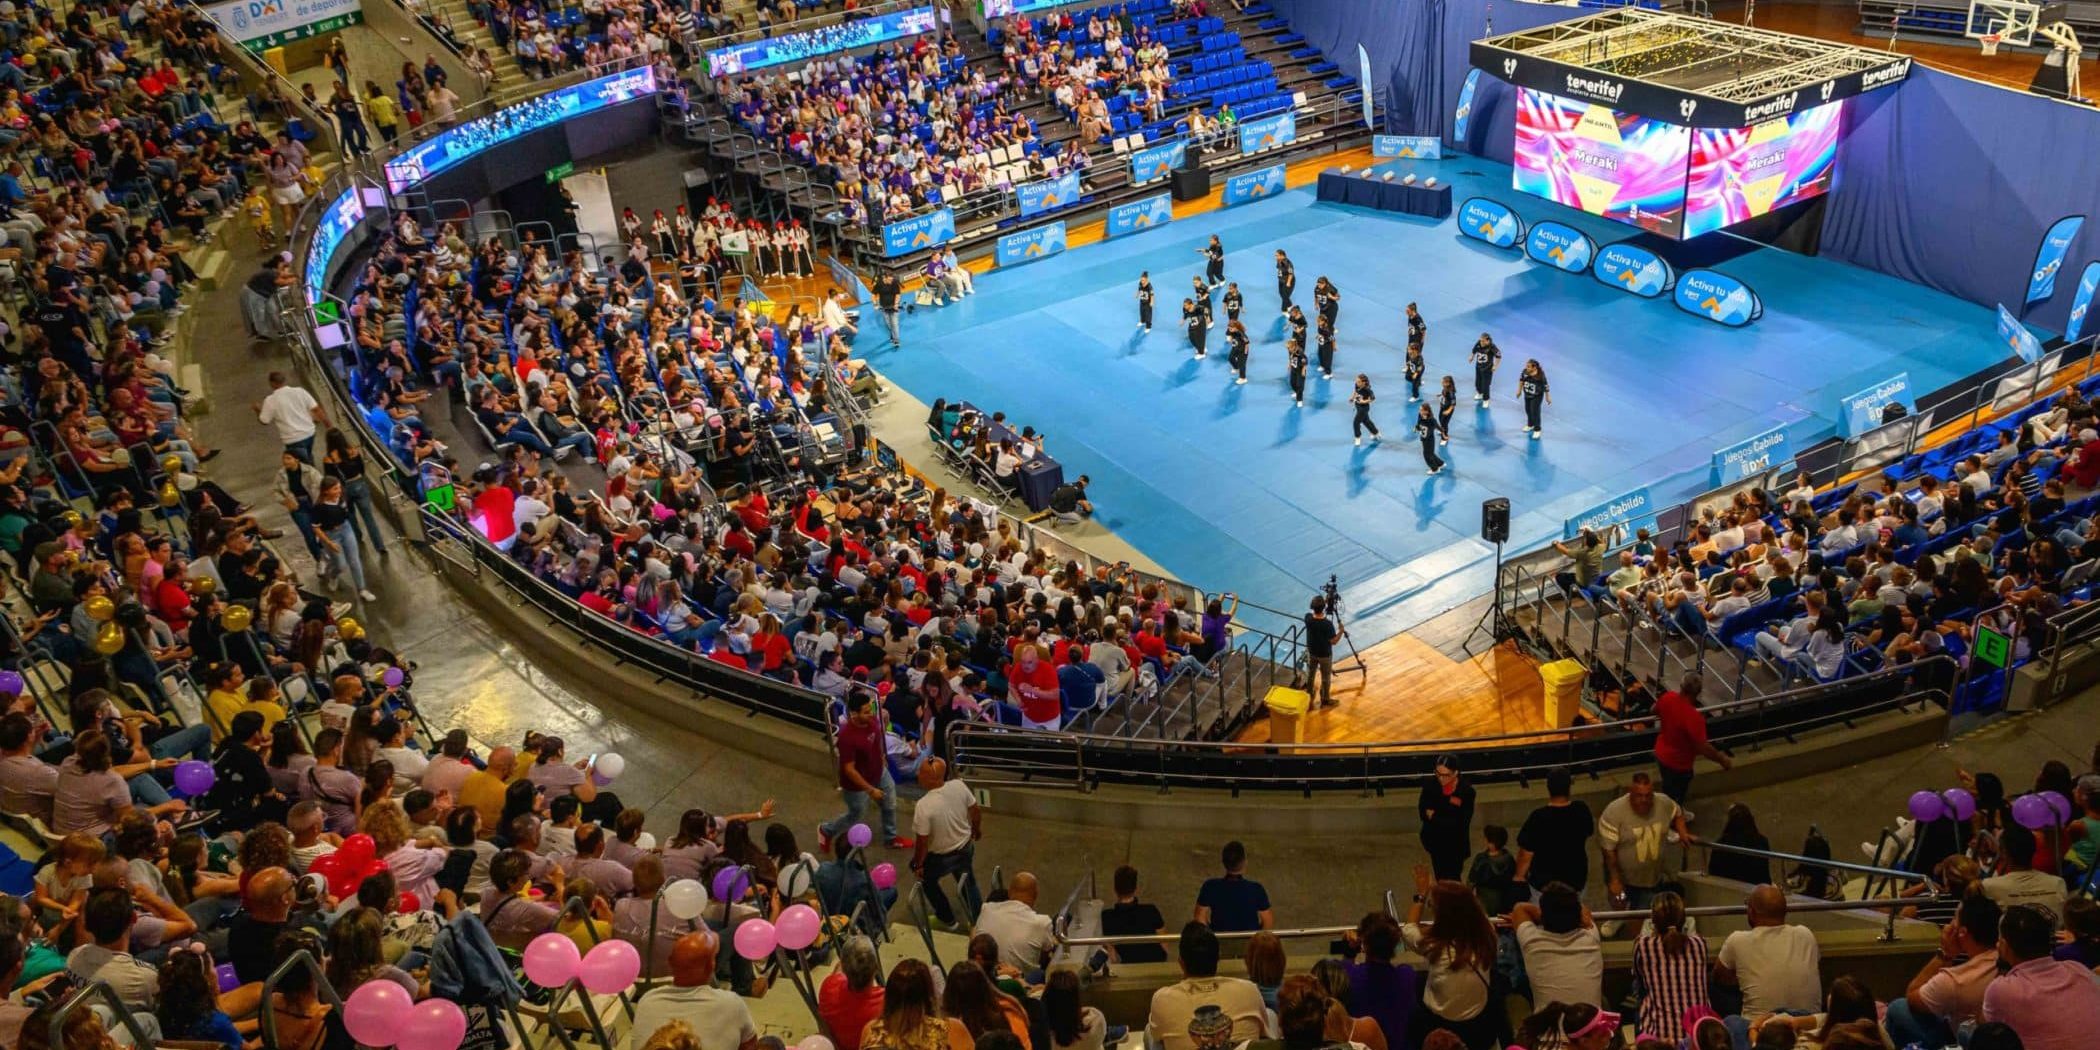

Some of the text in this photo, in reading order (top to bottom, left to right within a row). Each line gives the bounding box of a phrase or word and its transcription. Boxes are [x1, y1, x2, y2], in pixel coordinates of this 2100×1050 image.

[1138, 153, 1160, 164] Activa
[1575, 148, 1619, 172] Meraki
[1748, 148, 1785, 171] Meraki
[1023, 183, 1047, 196] Activa
[1118, 206, 1140, 217] Activa
[1468, 205, 1489, 220] Activa
[1490, 214, 1498, 223] tu
[891, 223, 918, 236] Activa
[919, 219, 929, 228] tu
[1007, 236, 1031, 247] Activa
[1032, 232, 1041, 240] tu
[1537, 228, 1560, 244] Activa
[1560, 236, 1569, 247] tu
[1605, 251, 1632, 267] Activa
[1632, 259, 1642, 270] tu
[1687, 276, 1715, 293] Activa
[1716, 284, 1726, 297] tu
[1476, 352, 1489, 364] 23
[1724, 432, 1784, 466] Juegos Cabildo
[1748, 453, 1770, 473] DXT
[1609, 495, 1645, 517] Cabildo
[1985, 637, 2001, 659] E
[1632, 821, 1663, 863] W
